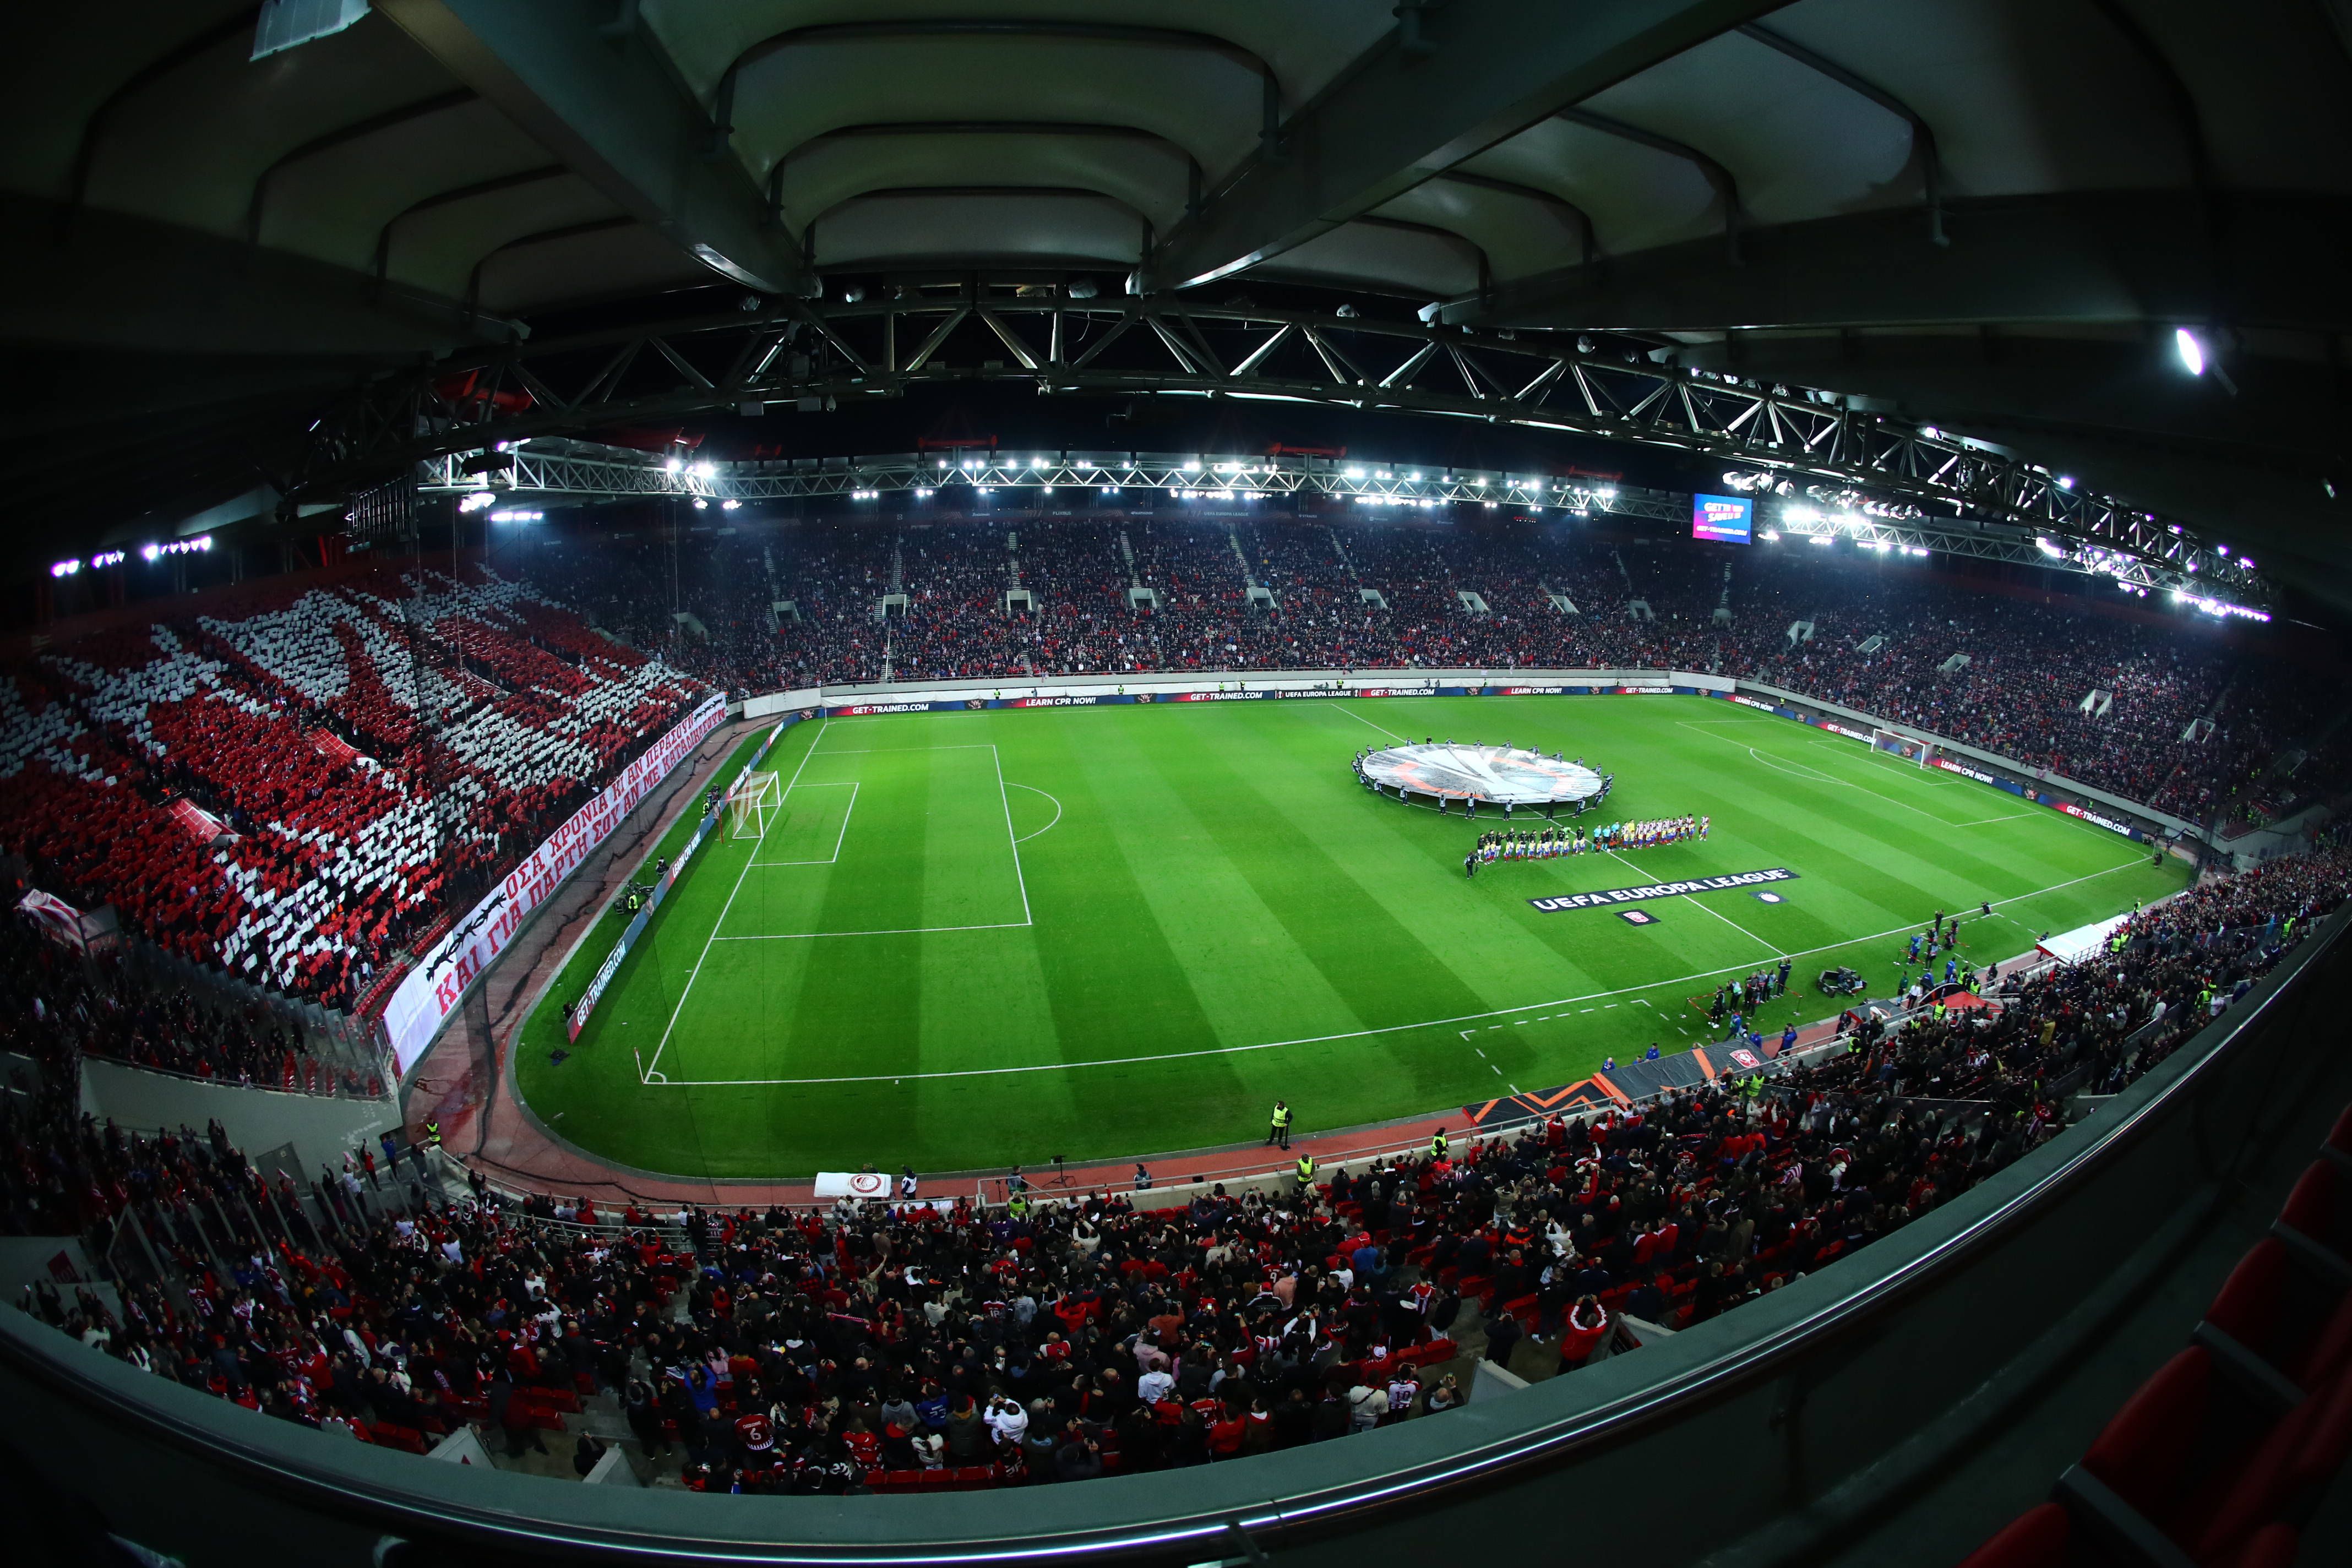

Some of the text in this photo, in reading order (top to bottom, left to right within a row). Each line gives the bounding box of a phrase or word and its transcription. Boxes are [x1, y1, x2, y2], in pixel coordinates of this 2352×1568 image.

[1073, 696, 1096, 705] NOW!
[1190, 692, 1262, 700] GET-TRAINED.COM
[1735, 696, 1751, 705] LEARN
[852, 704, 929, 714] GET-TRAINED.COM
[1941, 760, 1993, 785] LEARN CPR NOW!
[506, 713, 694, 900] ΟΣΑ ΧΡΟΝΙΑ ΚΙ ΑΝ ΠΕΡΑΣΟΥΝ
[2066, 805, 2131, 836] GET-TRAINED.COM
[672, 853, 685, 878] LEARN
[435, 945, 481, 1016] ΚΑΙ
[487, 900, 524, 956] ΓΙΑ
[529, 832, 589, 908] ΠΑΡΤΗ
[592, 804, 620, 844] ΣΟΥ
[623, 784, 639, 815] ΑΝ
[643, 764, 660, 793] ΜΕ
[1532, 869, 1787, 911] UEFA EUROPA LEAGUE
[577, 940, 627, 1027] GET-TRAINED.COM
[1270, 1272, 1277, 1283] 9
[750, 1427, 762, 1440] 6
